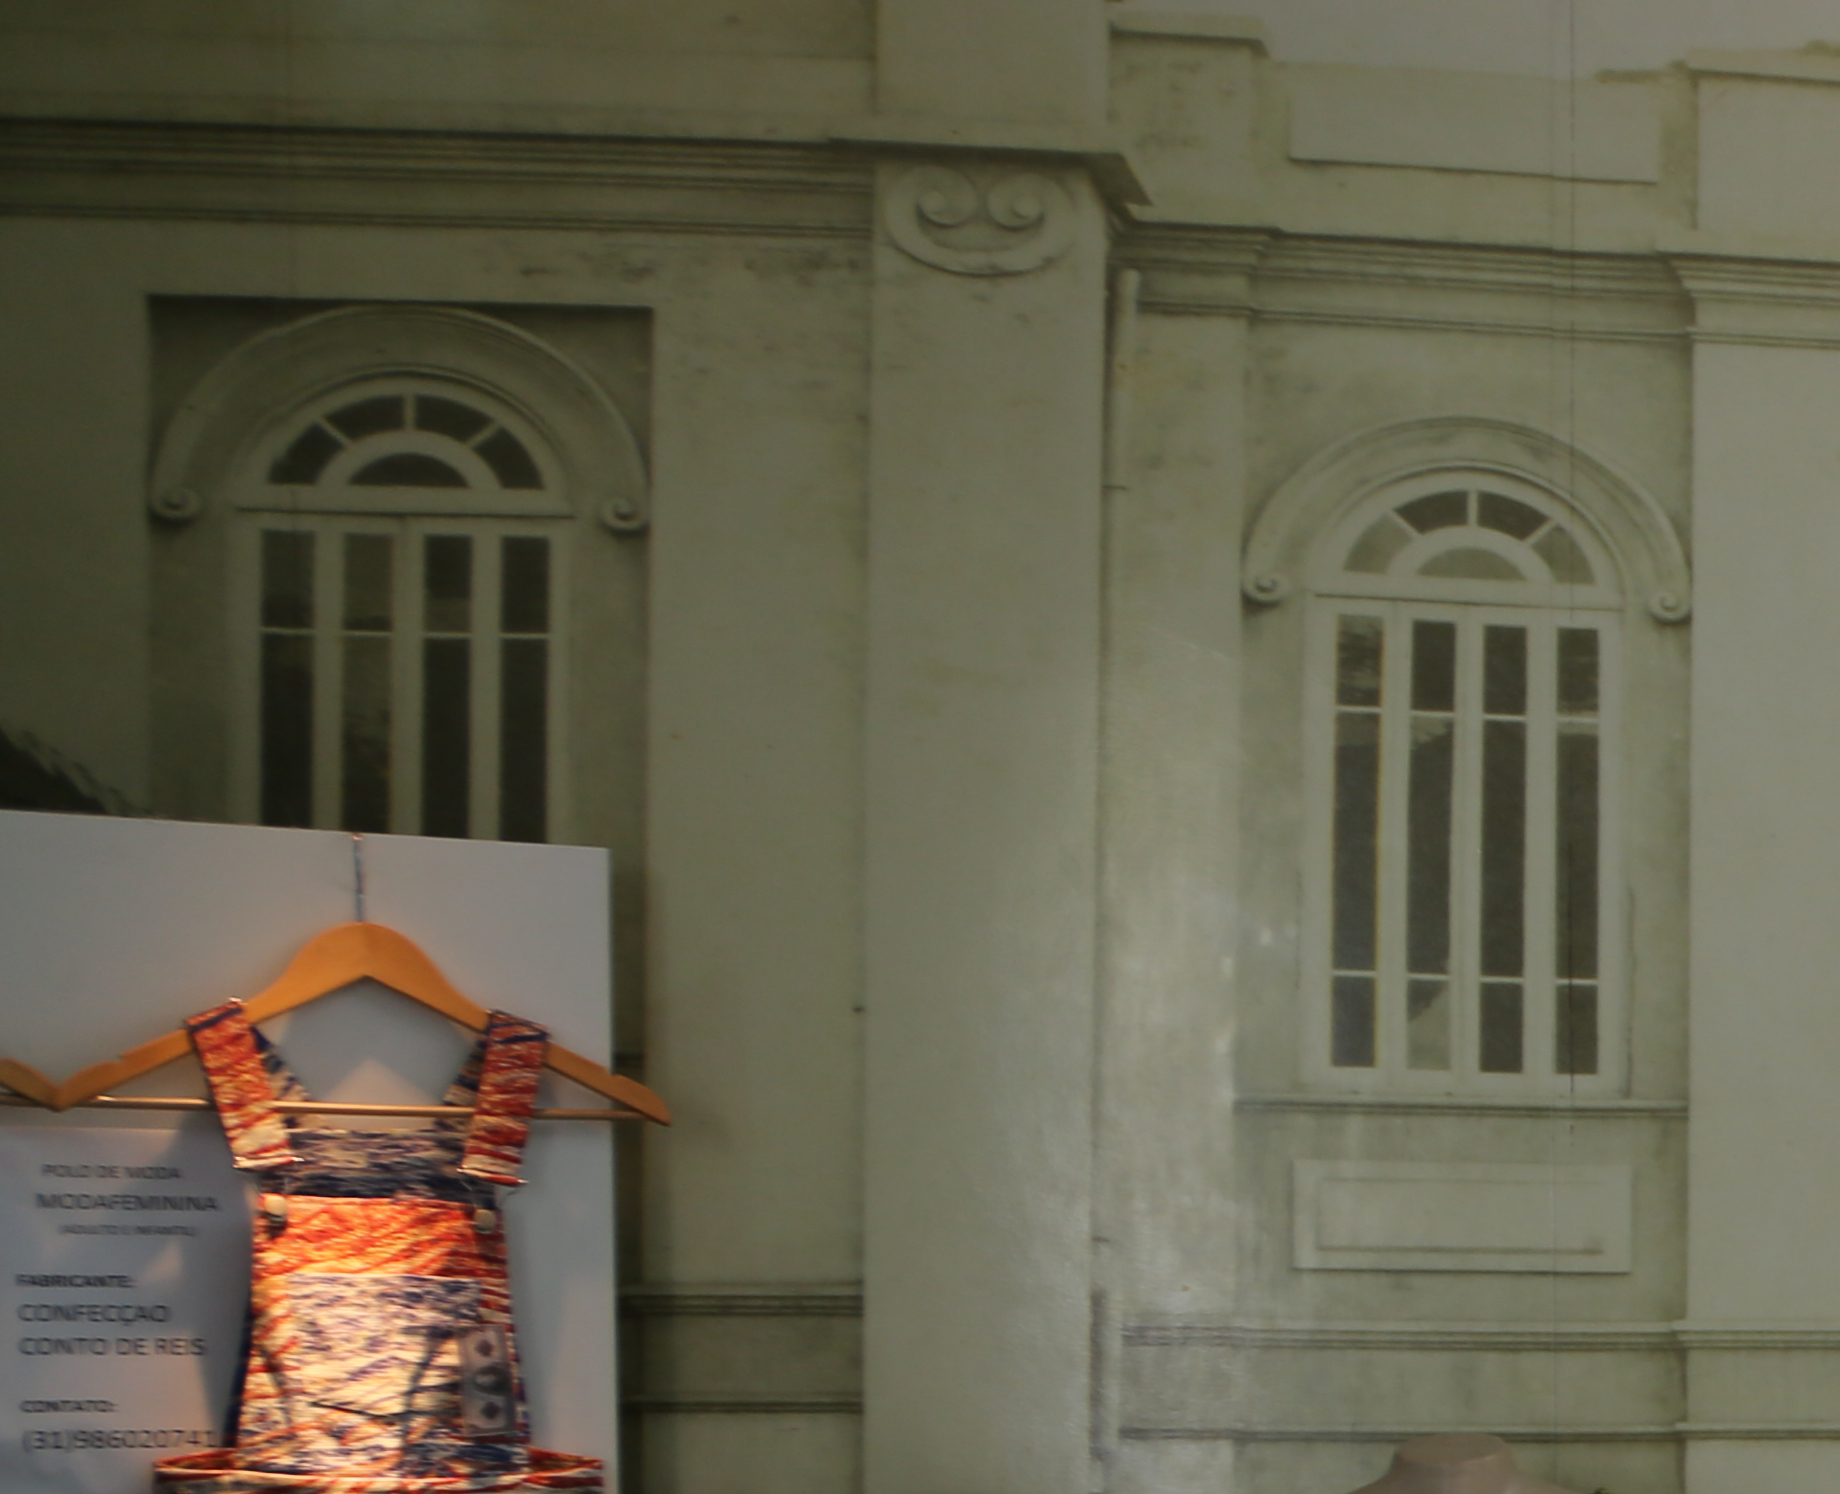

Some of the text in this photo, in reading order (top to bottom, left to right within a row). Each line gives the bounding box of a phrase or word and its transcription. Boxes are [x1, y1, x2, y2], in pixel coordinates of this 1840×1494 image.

[96, 1165, 119, 1180] DE
[19, 1337, 207, 1357] CONTO DE REIS
